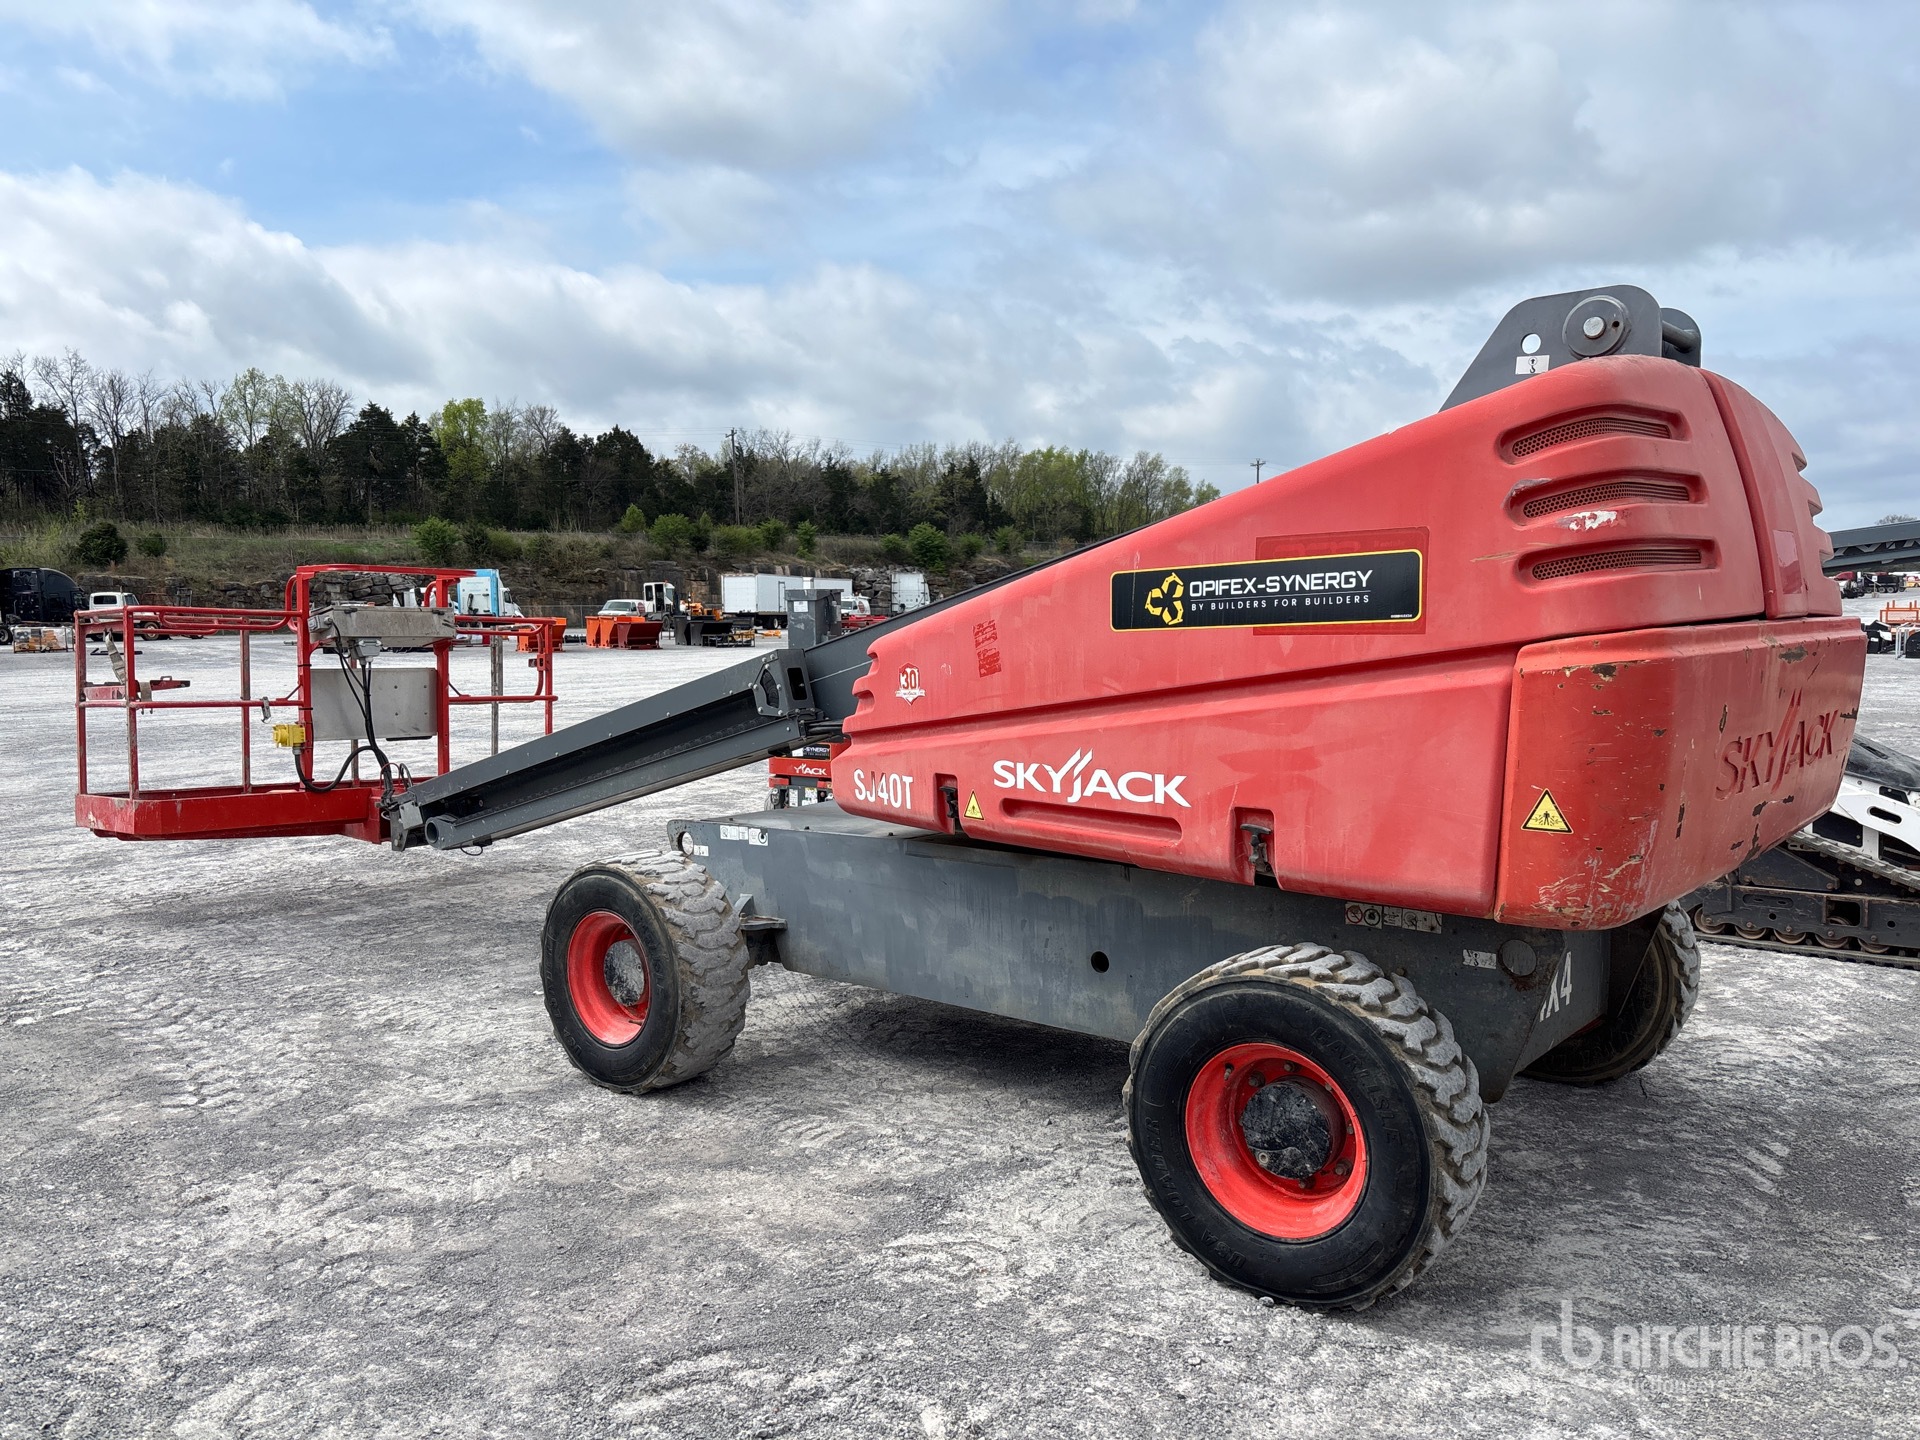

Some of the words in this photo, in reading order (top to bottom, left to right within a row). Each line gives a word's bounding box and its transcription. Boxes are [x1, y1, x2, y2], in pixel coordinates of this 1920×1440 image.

[1189, 569, 1374, 597] OPIFEX-SYNERGY
[1191, 603, 1204, 611] BY
[1210, 599, 1267, 611] BUILDERS
[1274, 598, 1297, 607] FOR
[1305, 594, 1369, 606] BUILDERS
[902, 669, 916, 690] 30
[1714, 687, 1838, 801] SKYJACK
[853, 768, 913, 810] SJ40T
[993, 747, 1192, 808] SKYJACK
